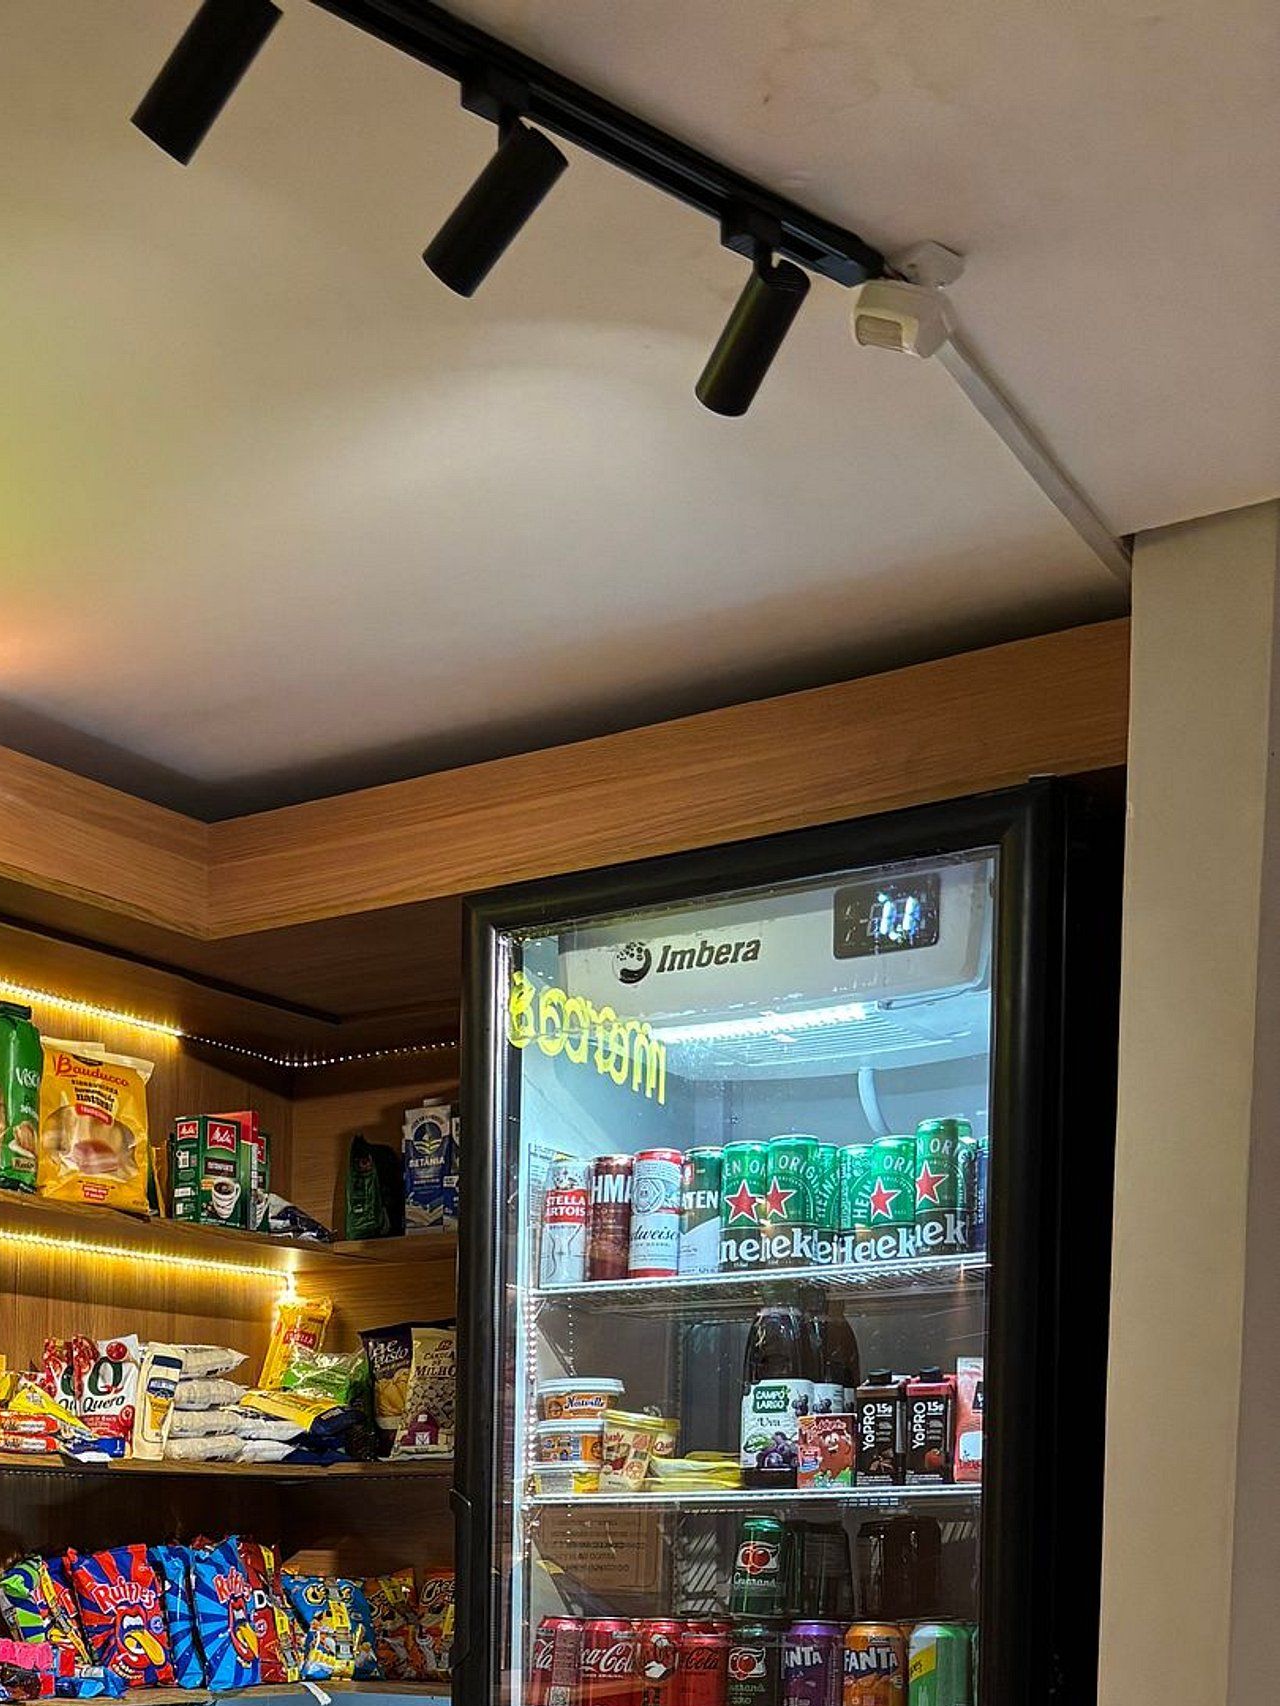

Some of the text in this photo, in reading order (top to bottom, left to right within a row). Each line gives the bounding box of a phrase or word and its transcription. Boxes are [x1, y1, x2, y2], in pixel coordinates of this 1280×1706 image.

[655, 937, 762, 974] Imbera
[54, 1053, 129, 1088] Bauducco
[83, 1395, 126, 1413] Quero
[755, 1388, 784, 1400] CAMPO
[756, 1400, 785, 1411] LARGO
[862, 1403, 876, 1451] YoPRO
[912, 1401, 926, 1449] YoPRO
[91, 1575, 156, 1615] Ruffles
[213, 1566, 253, 1604] Ruffles
[843, 1647, 899, 1672] FANTA
